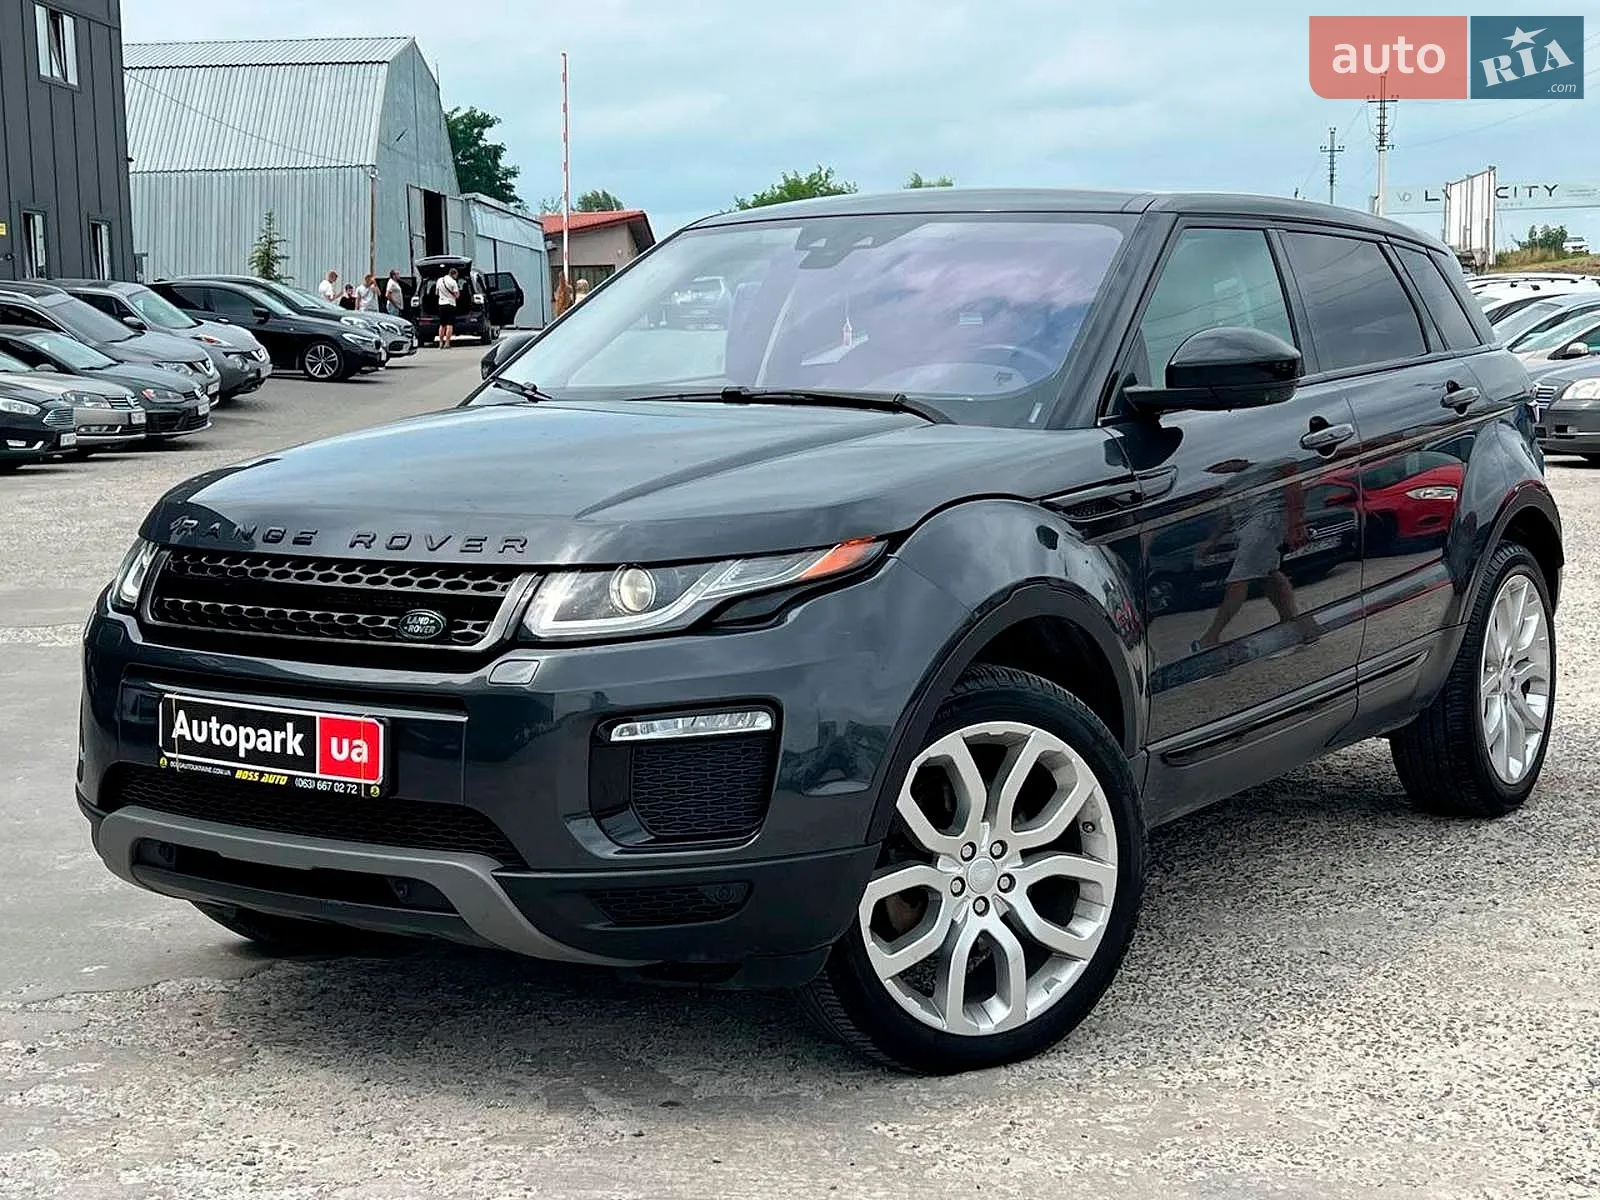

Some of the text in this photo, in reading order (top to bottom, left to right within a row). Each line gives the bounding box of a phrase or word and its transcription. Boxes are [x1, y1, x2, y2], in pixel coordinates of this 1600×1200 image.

[172, 519, 529, 554] RANGE ROVER
[407, 624, 437, 634] ROVER
[171, 709, 369, 764] Autopark ua
[234, 769, 260, 781] BOSS
[260, 773, 288, 786] AUTO
[316, 780, 332, 792] 667
[333, 783, 345, 793] 02
[346, 784, 358, 795] 72
